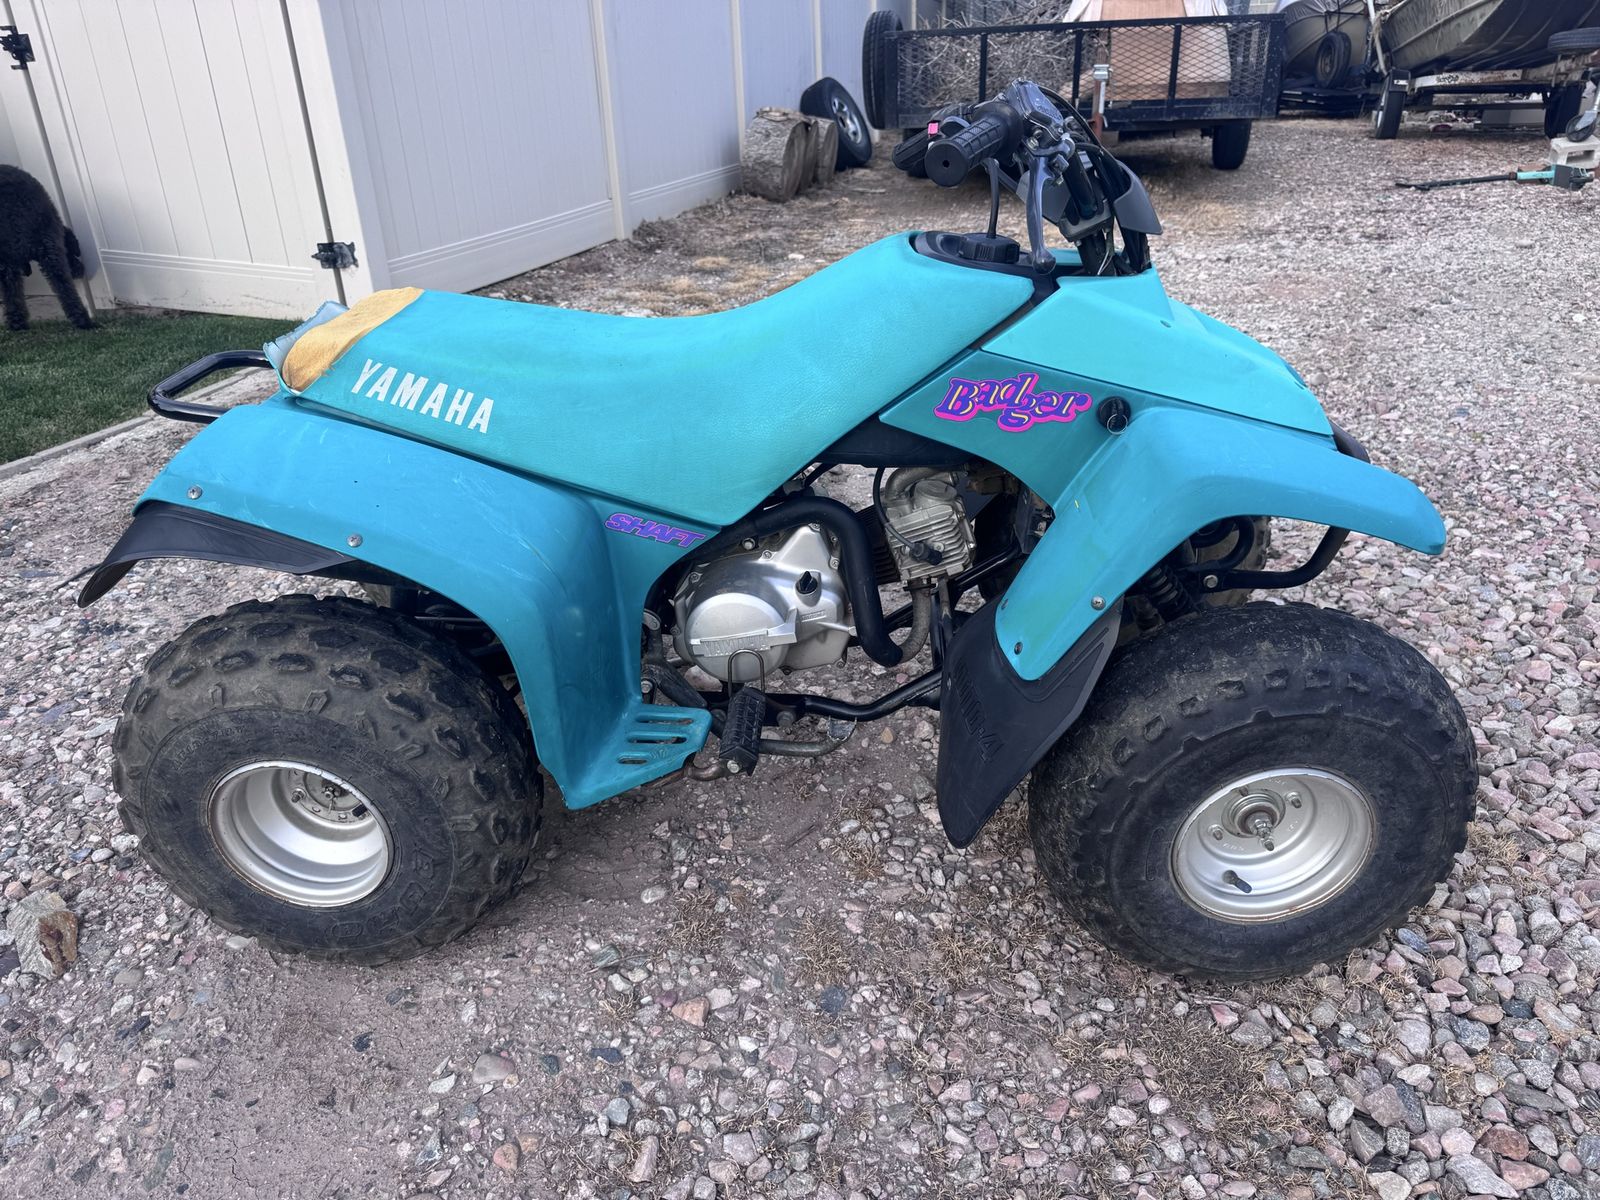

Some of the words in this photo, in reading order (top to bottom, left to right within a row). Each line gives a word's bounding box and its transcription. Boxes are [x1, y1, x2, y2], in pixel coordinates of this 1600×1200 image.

[351, 358, 495, 434] YAMAHA
[934, 373, 1093, 433] Badger
[605, 513, 706, 548] SHAFT
